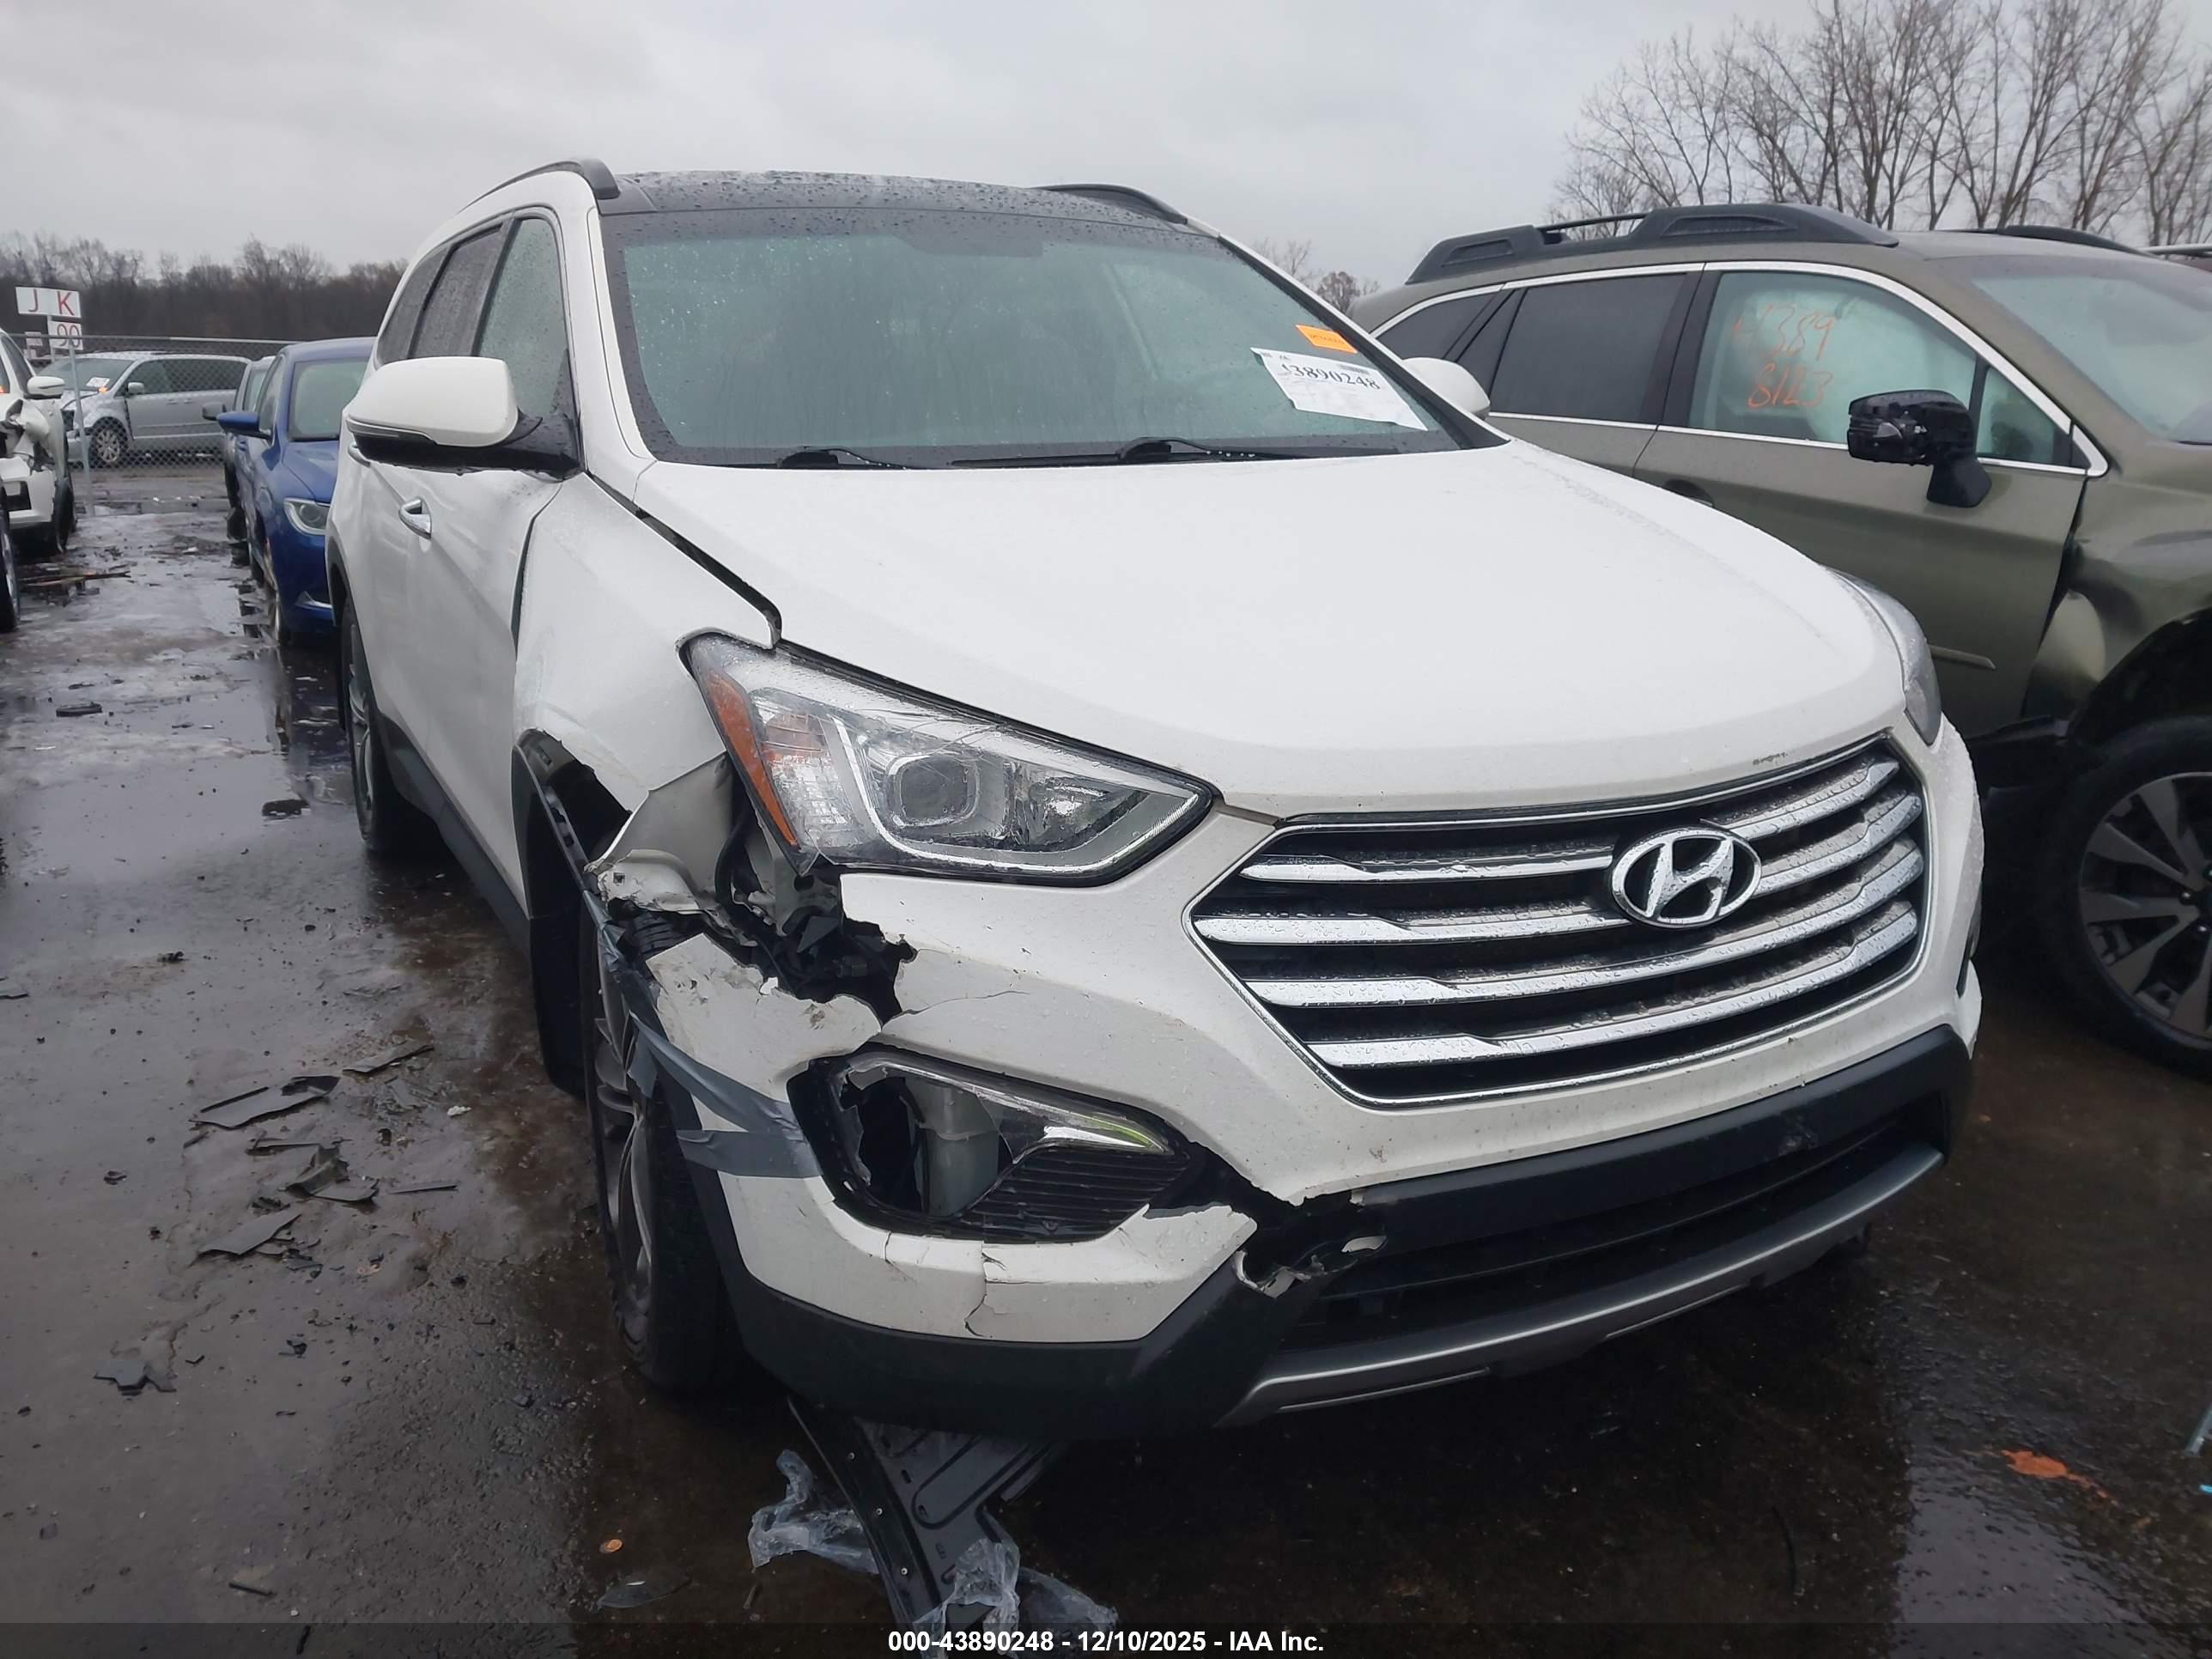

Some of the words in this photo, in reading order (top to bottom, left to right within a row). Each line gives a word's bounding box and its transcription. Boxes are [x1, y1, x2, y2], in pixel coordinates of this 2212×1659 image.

[28, 288, 39, 313] J
[57, 290, 75, 316] K
[57, 323, 81, 348] 90
